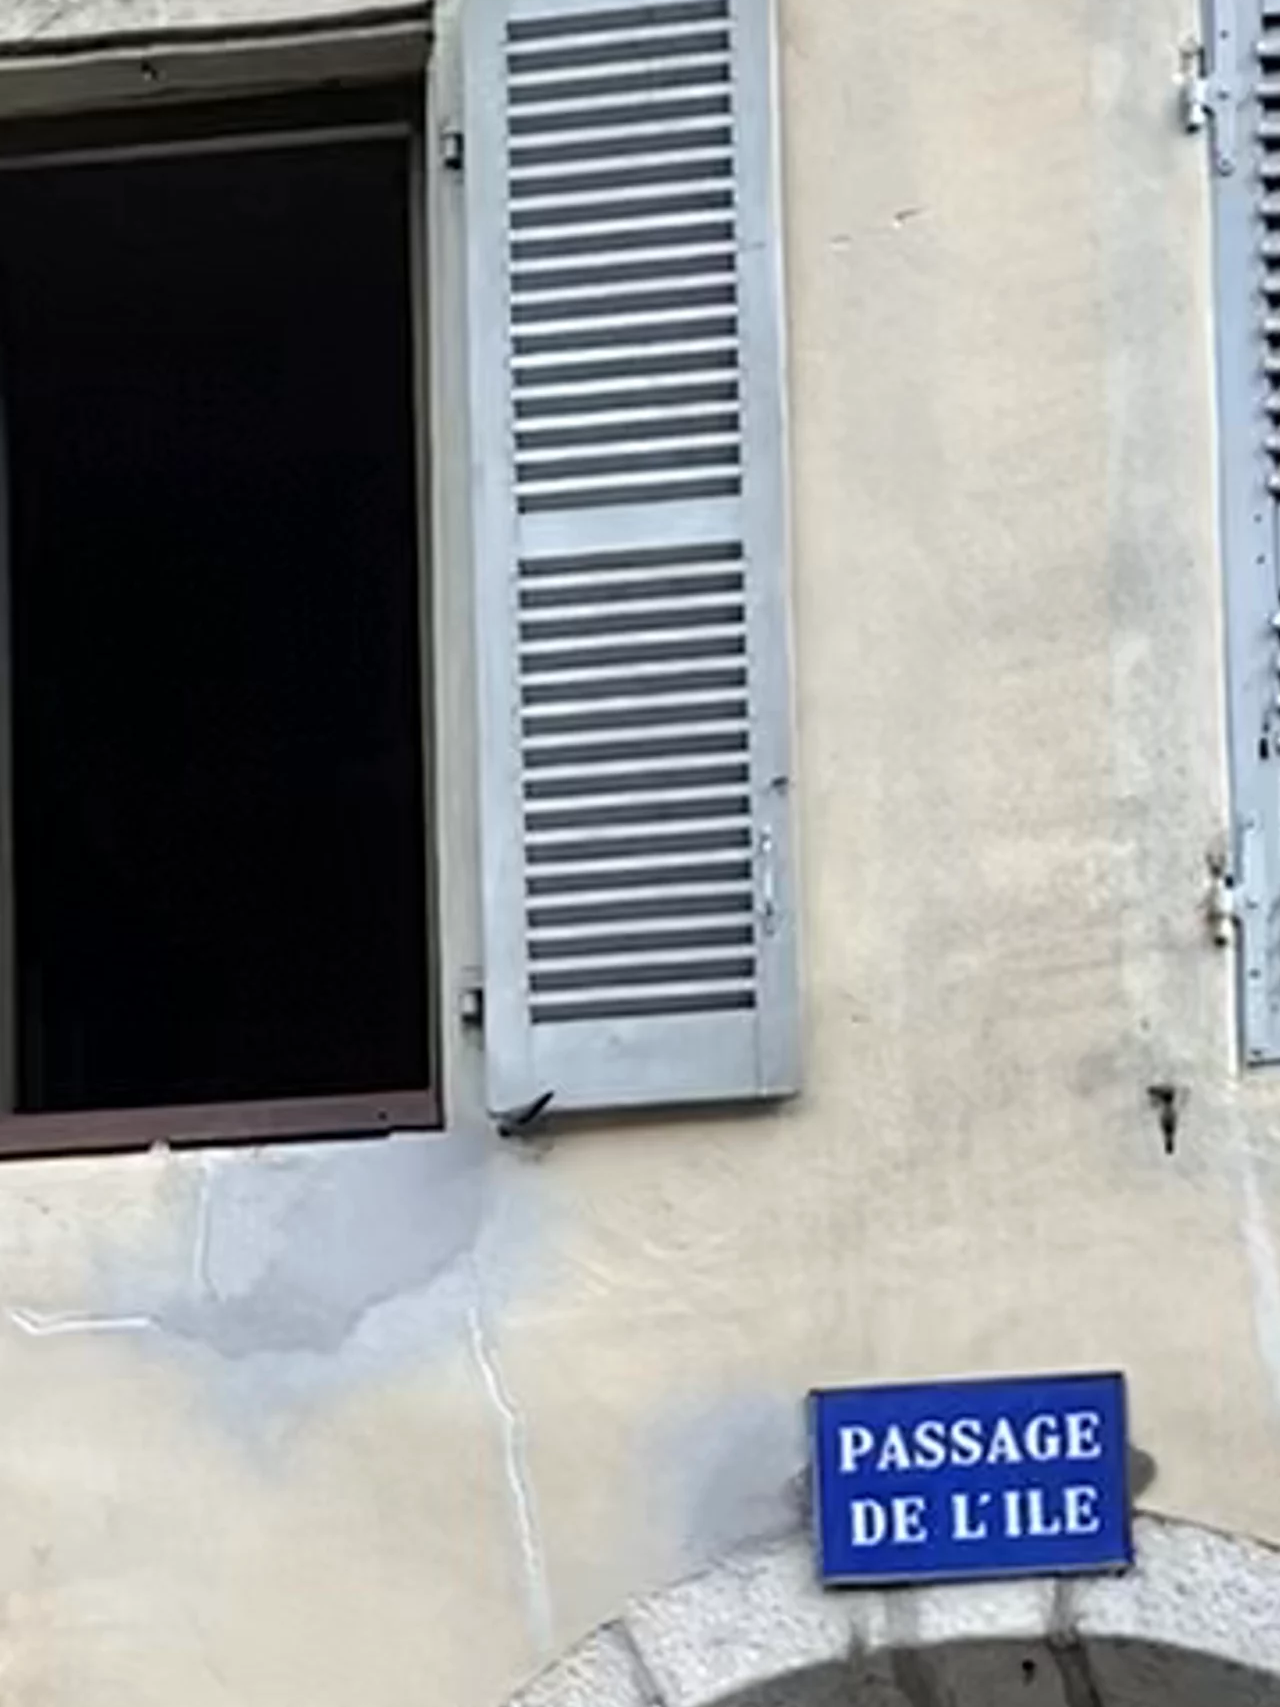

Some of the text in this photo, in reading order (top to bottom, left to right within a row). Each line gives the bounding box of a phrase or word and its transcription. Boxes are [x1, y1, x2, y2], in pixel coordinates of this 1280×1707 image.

[838, 1411, 1102, 1473] PASSAGE
[850, 1485, 1101, 1547] DE L'ILE
